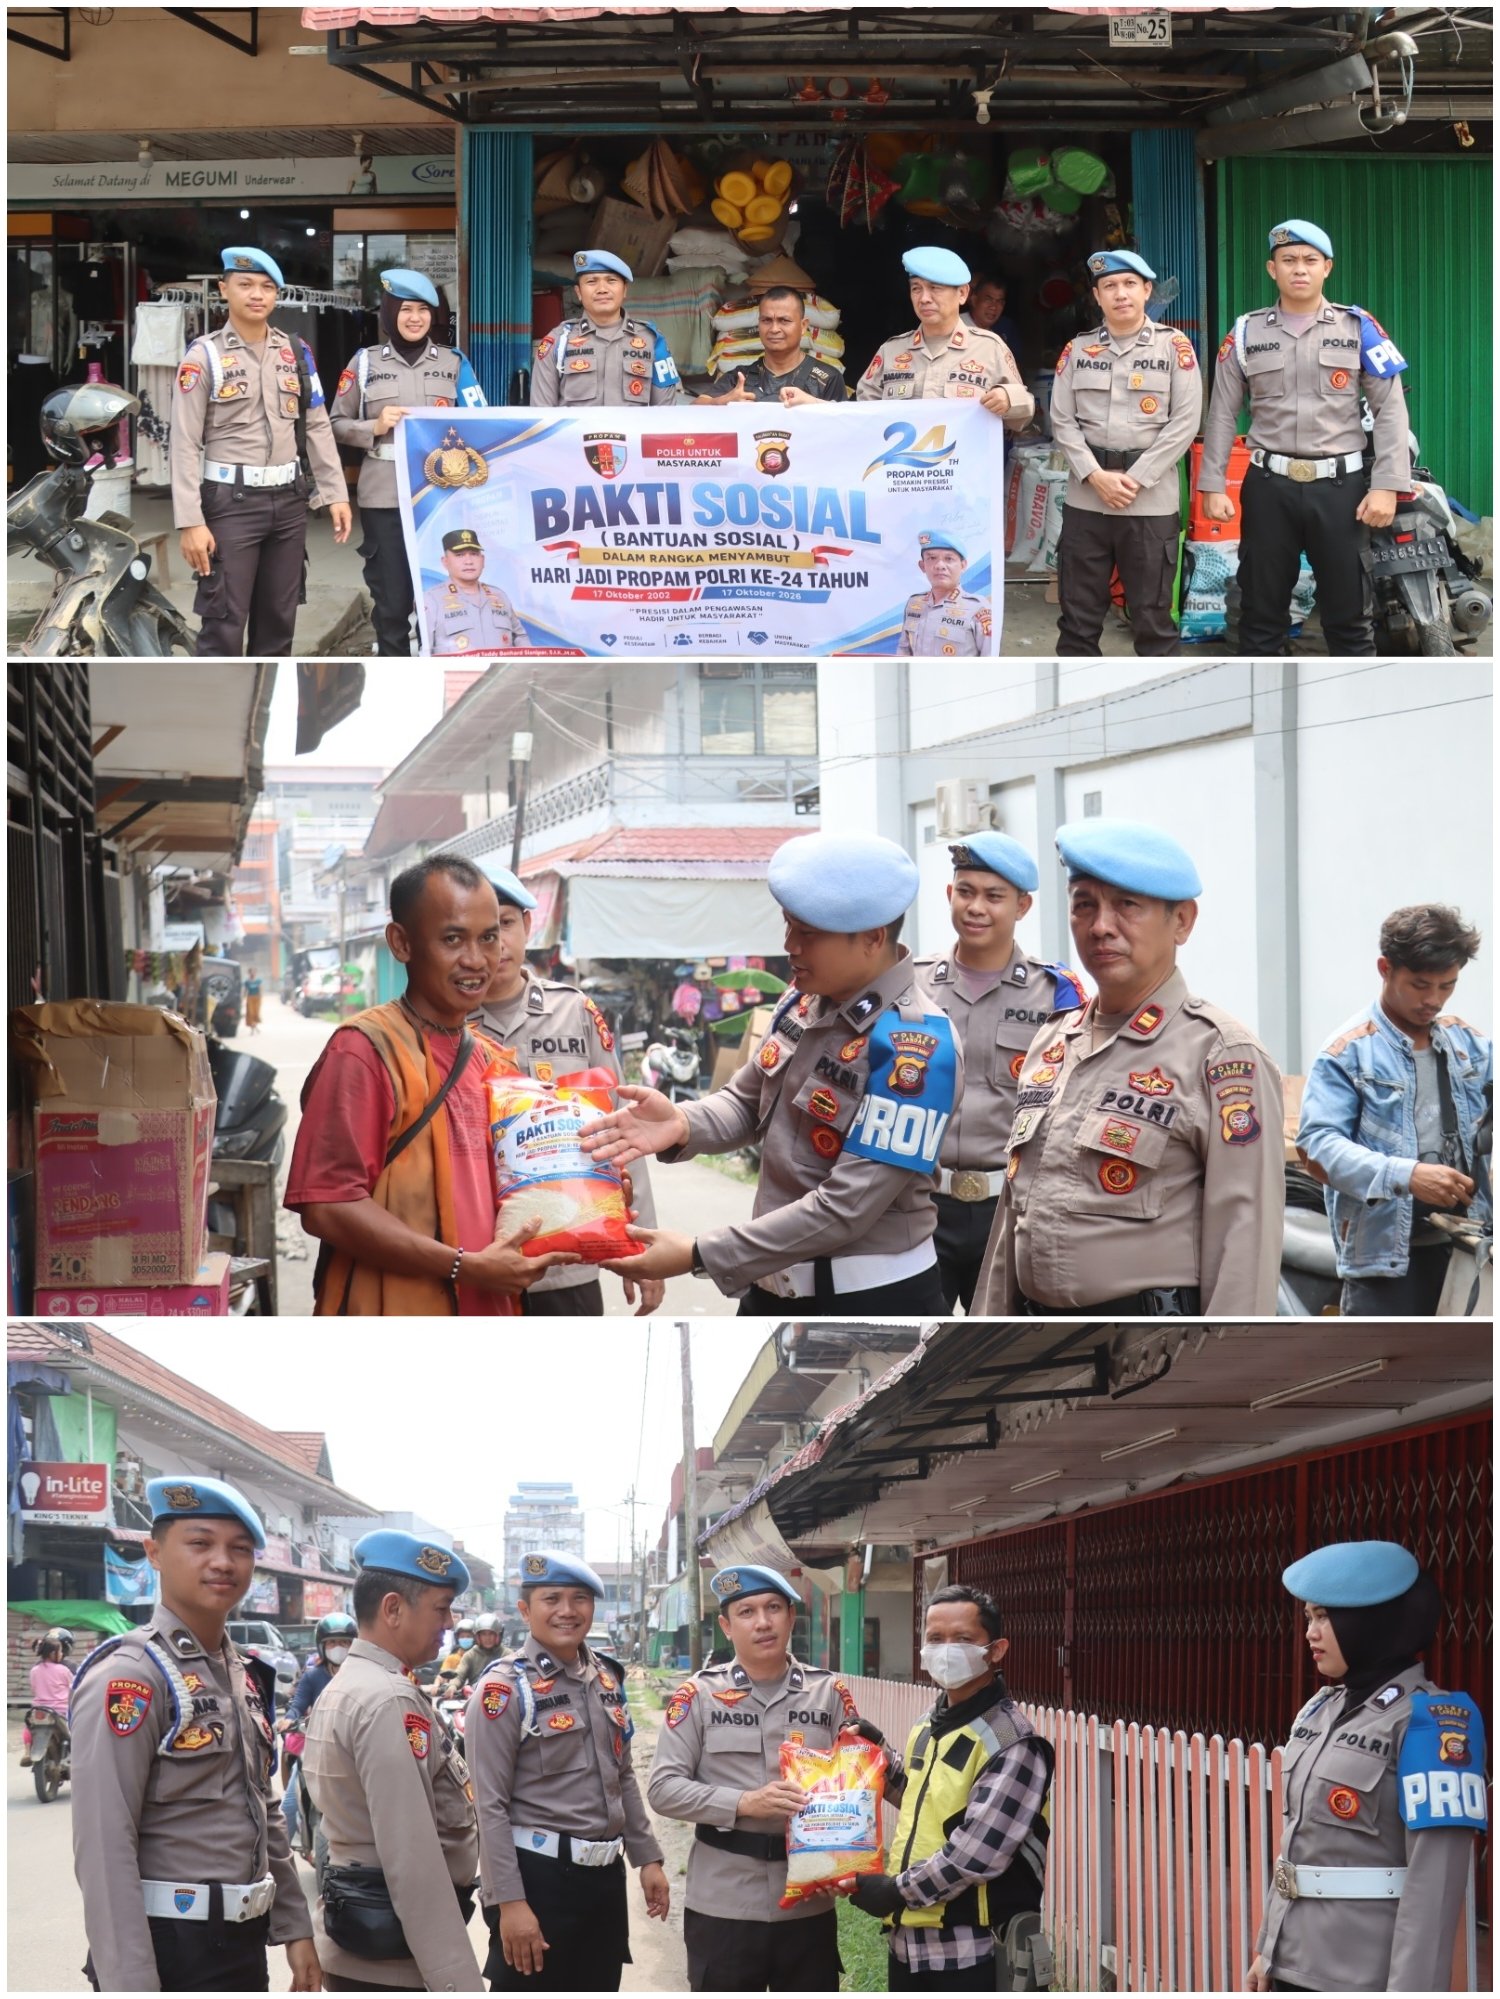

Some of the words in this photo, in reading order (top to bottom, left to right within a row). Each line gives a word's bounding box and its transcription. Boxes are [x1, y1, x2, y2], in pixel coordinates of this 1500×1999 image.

[52, 173, 95, 188] Selamat
[98, 174, 137, 192] Datang
[140, 170, 150, 186] di
[165, 171, 238, 187] MEGUMI
[244, 174, 296, 186] Underwear
[1322, 338, 1359, 350] POLRI
[622, 350, 652, 359] POLRI
[1076, 359, 1112, 371] NASDI
[1132, 360, 1170, 371] POLRI
[950, 372, 988, 386] POLRI
[656, 448, 685, 457] POLRI
[688, 448, 721, 457] UNTUK
[657, 460, 722, 468] MASYARAKAT
[886, 470, 924, 478] PROPAM
[926, 469, 954, 478] POLRI
[1030, 484, 1047, 528] BRAVO
[530, 482, 682, 542] BAKTI
[692, 482, 882, 545] SOSIAL
[614, 532, 707, 548] BANTUAN
[713, 532, 788, 550] SOSIAL
[602, 552, 645, 562] DALAM
[650, 552, 704, 564] RANGKA
[708, 552, 791, 564] MENYAMBUT
[531, 568, 570, 584] HARI
[575, 568, 612, 586] JADI
[616, 569, 690, 587] PROPAM
[696, 568, 746, 586] POLRI
[751, 568, 803, 588] KE-24
[808, 570, 869, 588] TAHUN
[592, 590, 603, 598] 17
[605, 590, 644, 600] Oktober
[646, 590, 671, 600] 2002
[722, 588, 733, 597] 17
[736, 588, 776, 598] Oktober
[778, 590, 802, 600] 2026
[672, 606, 702, 614] DALAM
[667, 614, 696, 622] UNTUK
[942, 618, 965, 626] POLRI
[1004, 1008, 1051, 1024] POLR
[892, 1032, 936, 1045] POLRES
[532, 1038, 586, 1054] POLRI
[814, 1056, 859, 1090] POLRI
[1210, 1062, 1252, 1076] POLRES
[1220, 1068, 1244, 1078] LANDAK
[1102, 1091, 1175, 1125] POLRI
[516, 1120, 555, 1147] BAKTI
[846, 1094, 950, 1162] PROV
[111, 1680, 150, 1696] PROPAM
[711, 1710, 759, 1726] NASDI
[788, 1710, 832, 1727] POLRI
[1336, 1732, 1391, 1756] POLRI
[1402, 1770, 1488, 1822] PRO
[827, 1802, 862, 1816] SOSIAL
